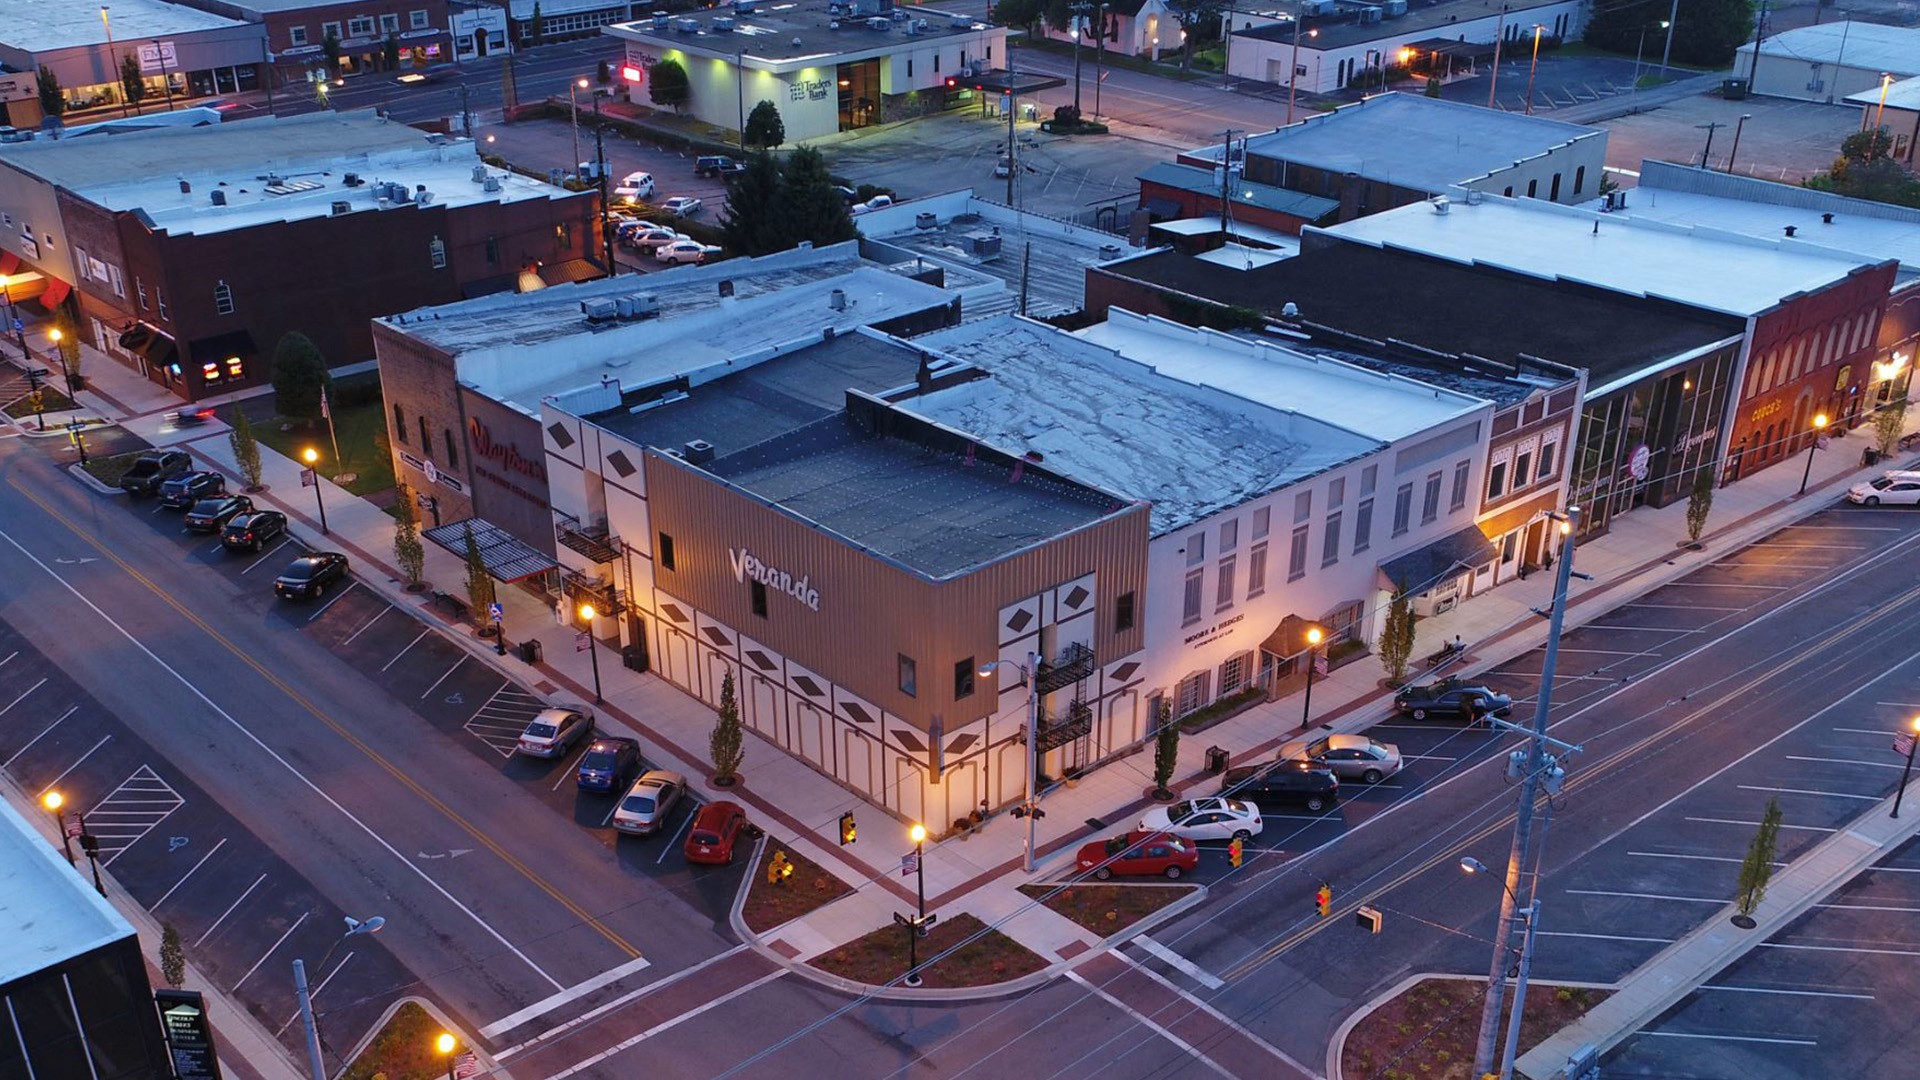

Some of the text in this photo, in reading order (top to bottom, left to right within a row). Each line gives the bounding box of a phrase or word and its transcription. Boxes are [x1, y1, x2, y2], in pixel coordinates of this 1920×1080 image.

[804, 79, 832, 91] Traders
[809, 88, 828, 100] Bank
[728, 547, 819, 612] Veranda
[1185, 629, 1209, 644] MOORE
[1218, 614, 1244, 629] HEDGES
